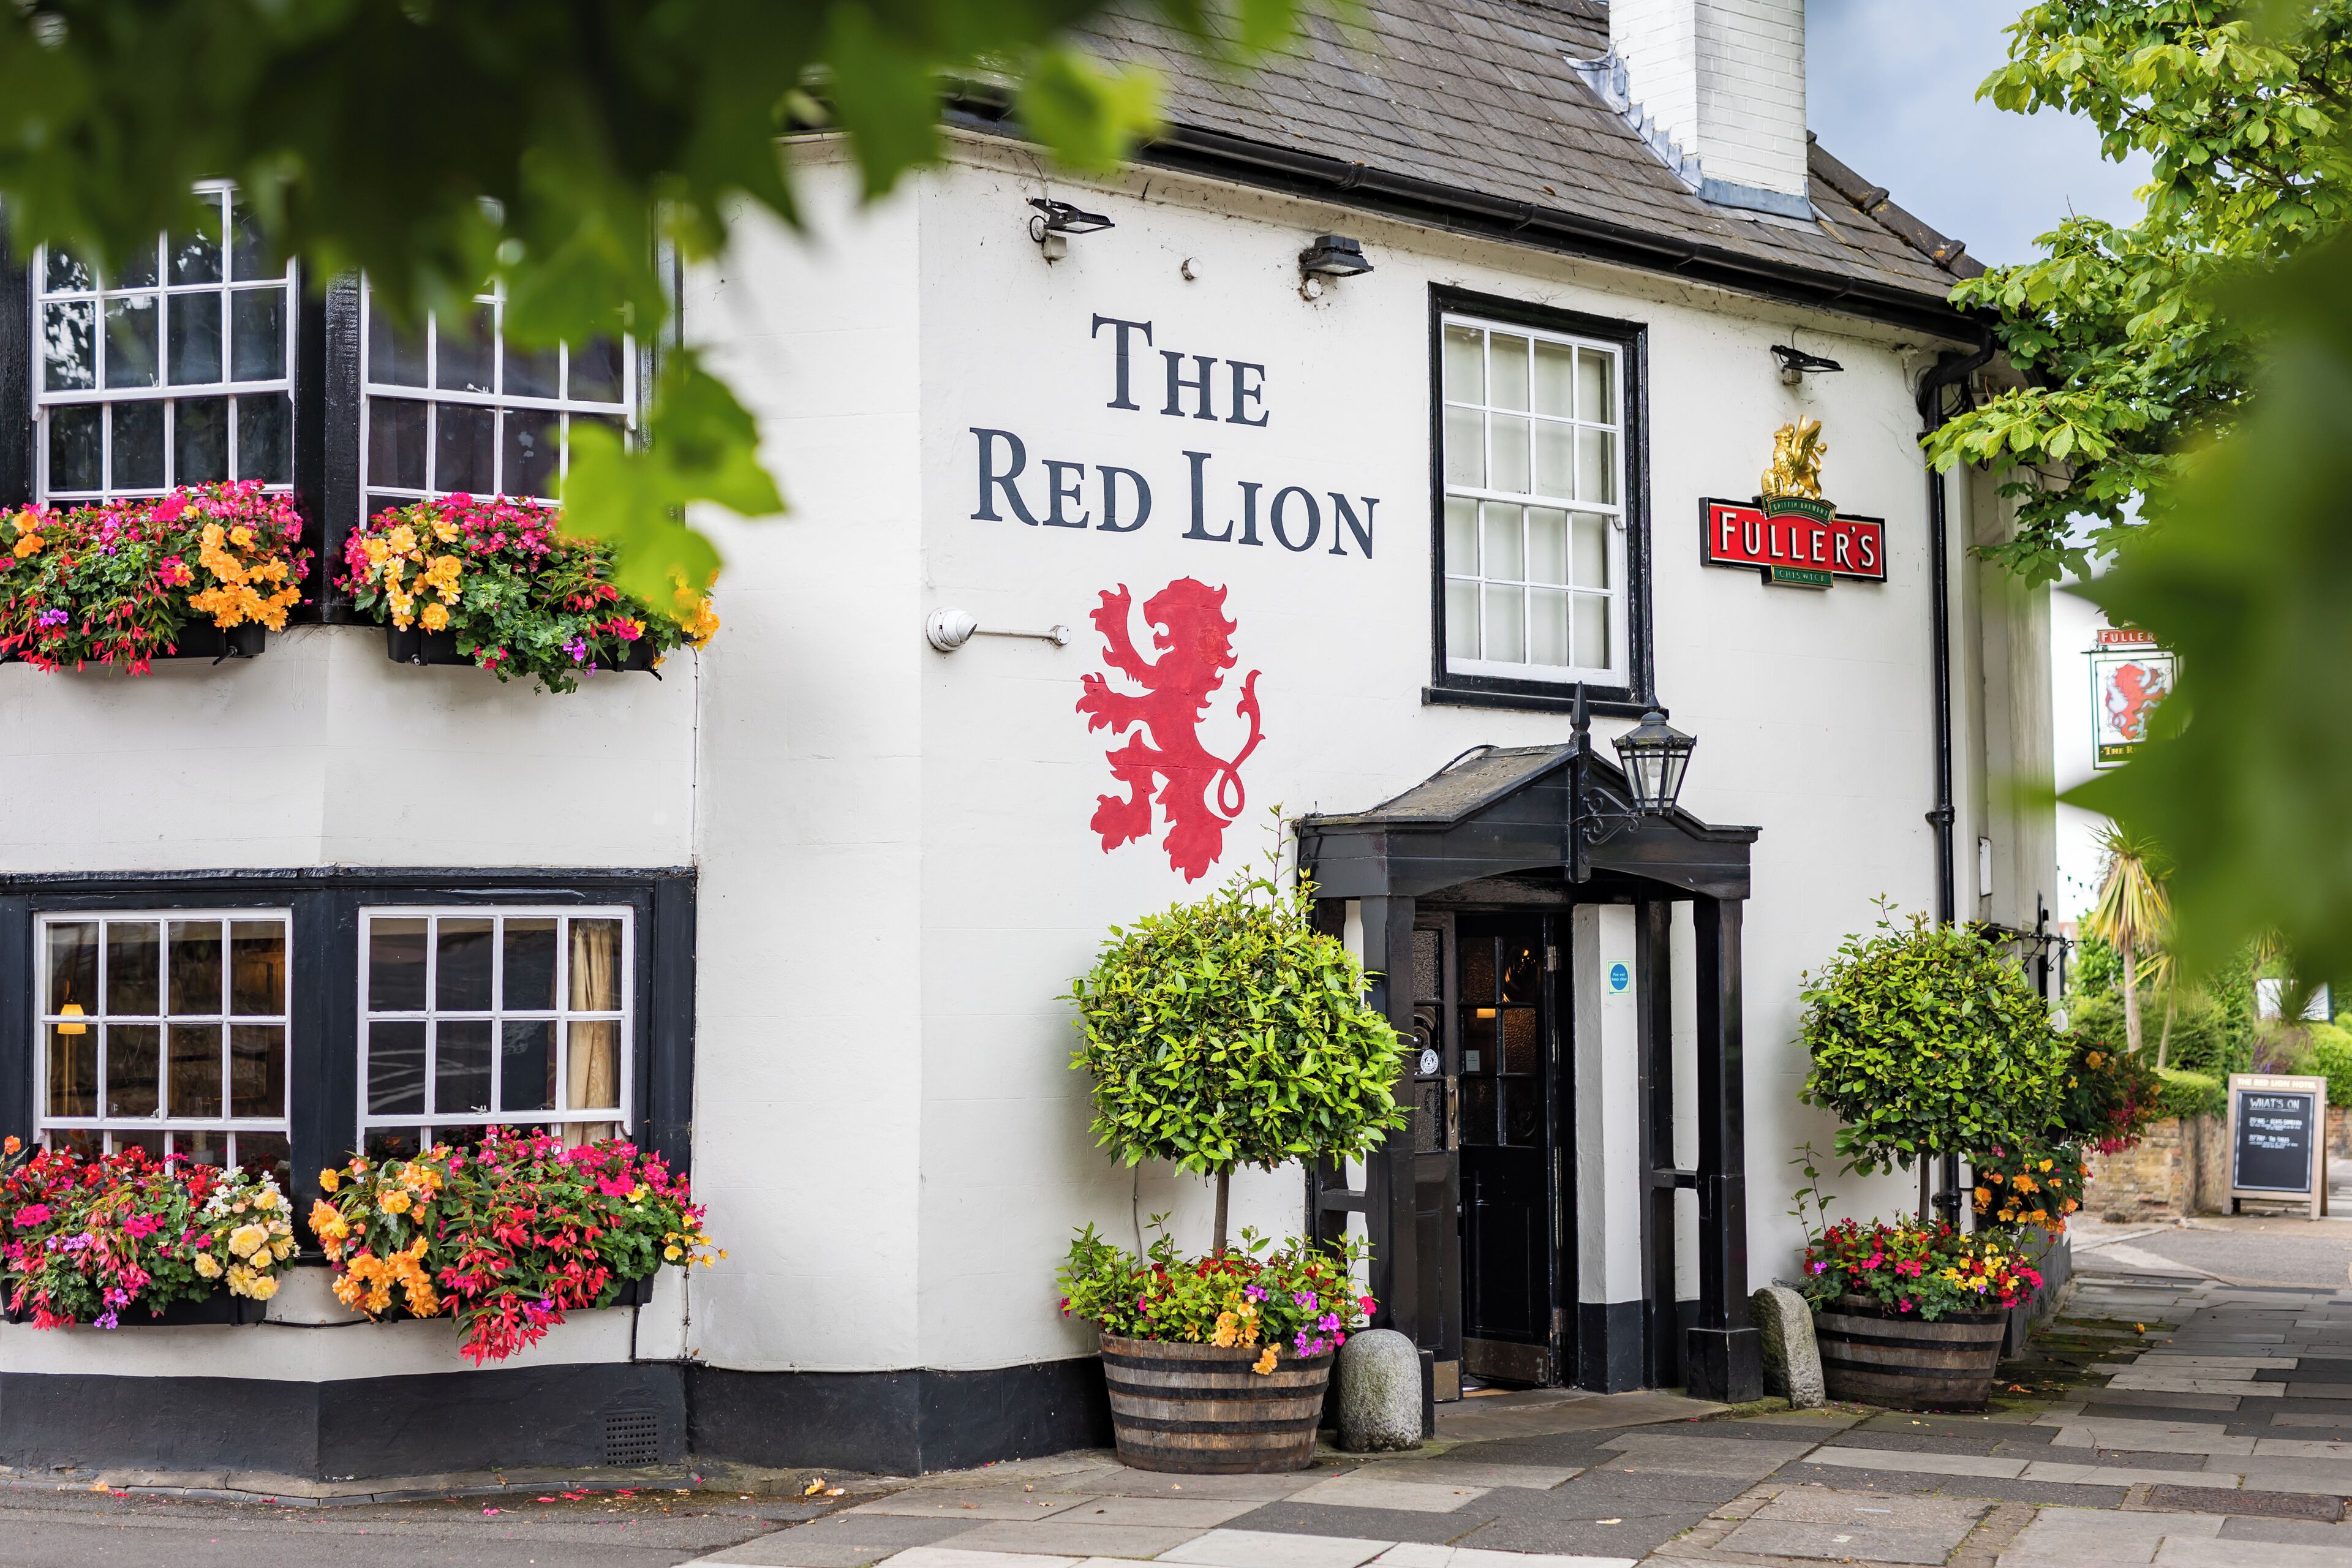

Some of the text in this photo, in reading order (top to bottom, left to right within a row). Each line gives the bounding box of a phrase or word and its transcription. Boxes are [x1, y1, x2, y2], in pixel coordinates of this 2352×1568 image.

[1092, 312, 1270, 428] THE
[970, 427, 1380, 560] RED LION
[1773, 502, 1828, 516] GRIFFIN BREWERY
[1719, 511, 1875, 570] FULLER'S
[1779, 570, 1825, 582] CHISWICK
[2101, 631, 2156, 643] FULLER
[2292, 1080, 2316, 1088] HOTEL
[2249, 1098, 2300, 1110] WHAT'S ON
